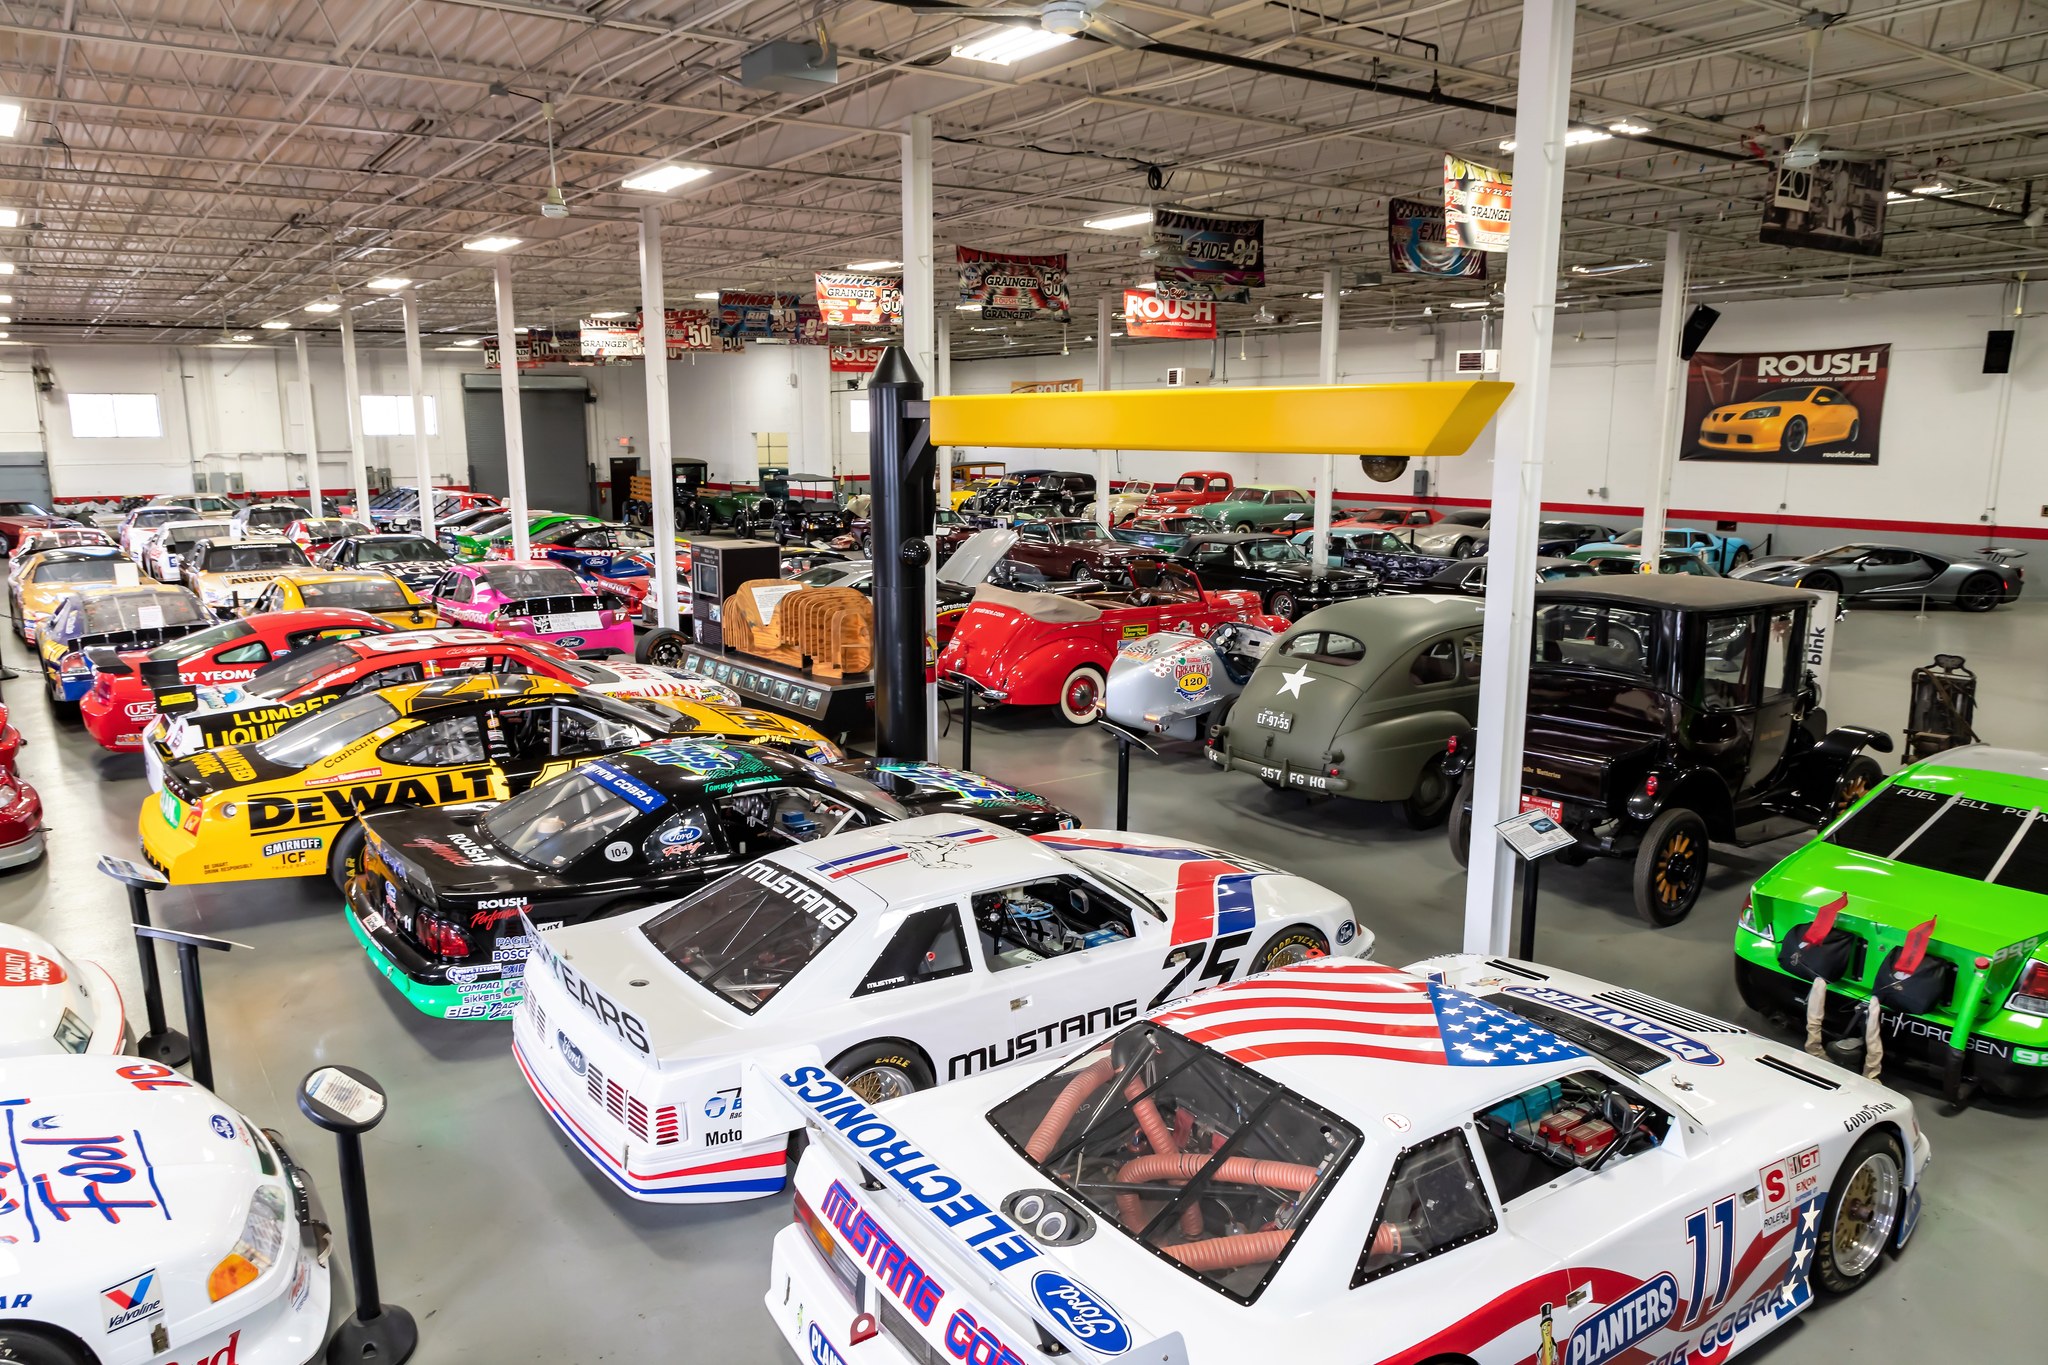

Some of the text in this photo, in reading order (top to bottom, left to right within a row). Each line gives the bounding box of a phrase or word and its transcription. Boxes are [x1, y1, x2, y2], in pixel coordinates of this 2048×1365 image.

[826, 288, 875, 299] GRAINGER
[985, 275, 1038, 289] GRAINGER
[1125, 294, 1212, 321] ROUSH
[583, 340, 628, 349] GRAINGER
[688, 324, 712, 346] 50
[1758, 352, 1878, 378] ROUSH
[560, 637, 581, 648] Ford
[1807, 626, 1826, 666] blink
[1175, 664, 1195, 679] GREAT
[1184, 677, 1203, 687] 120
[323, 735, 378, 769] Carhartt
[703, 780, 734, 795] Tommy
[1260, 766, 1326, 789] 357 FG HQ
[249, 767, 494, 831] DEWALT
[613, 778, 655, 805] COBRA
[1896, 788, 1937, 801] FUEL
[264, 838, 321, 856] SMIRNOFF
[669, 829, 694, 841] Ford
[446, 833, 491, 864] ROUSH
[610, 846, 628, 858] 104
[477, 896, 527, 910] ROUSH
[740, 862, 852, 931] MUSTANG
[470, 904, 534, 930] Performance
[5, 952, 27, 982] QUALITY
[1146, 932, 1253, 1011] 25
[458, 981, 500, 993] COMPAQ
[867, 975, 906, 989] MUSTANG
[464, 992, 502, 1004] sikkens
[445, 1004, 486, 1019] BBS
[1519, 986, 1712, 1061] PLANTERS
[560, 1036, 584, 1070] Ford
[947, 998, 1138, 1082] MUSTANG
[874, 1054, 912, 1068] EAGLE
[1843, 1100, 1897, 1133] GOODYEAR
[780, 1066, 1040, 1272] ELECTRONICS
[1800, 1149, 1819, 1169] GT
[1765, 1168, 1786, 1203] S
[1796, 1174, 1817, 1192] EXXON
[1763, 1211, 1784, 1228] ROLEX
[820, 1178, 945, 1327] MUSTANG
[1683, 1194, 1737, 1330] 11
[108, 1299, 161, 1329] Valvoline
[1047, 1284, 1117, 1339] Ford
[1570, 1281, 1674, 1365] PLANTERS
[1700, 1283, 1789, 1355] COBRA
